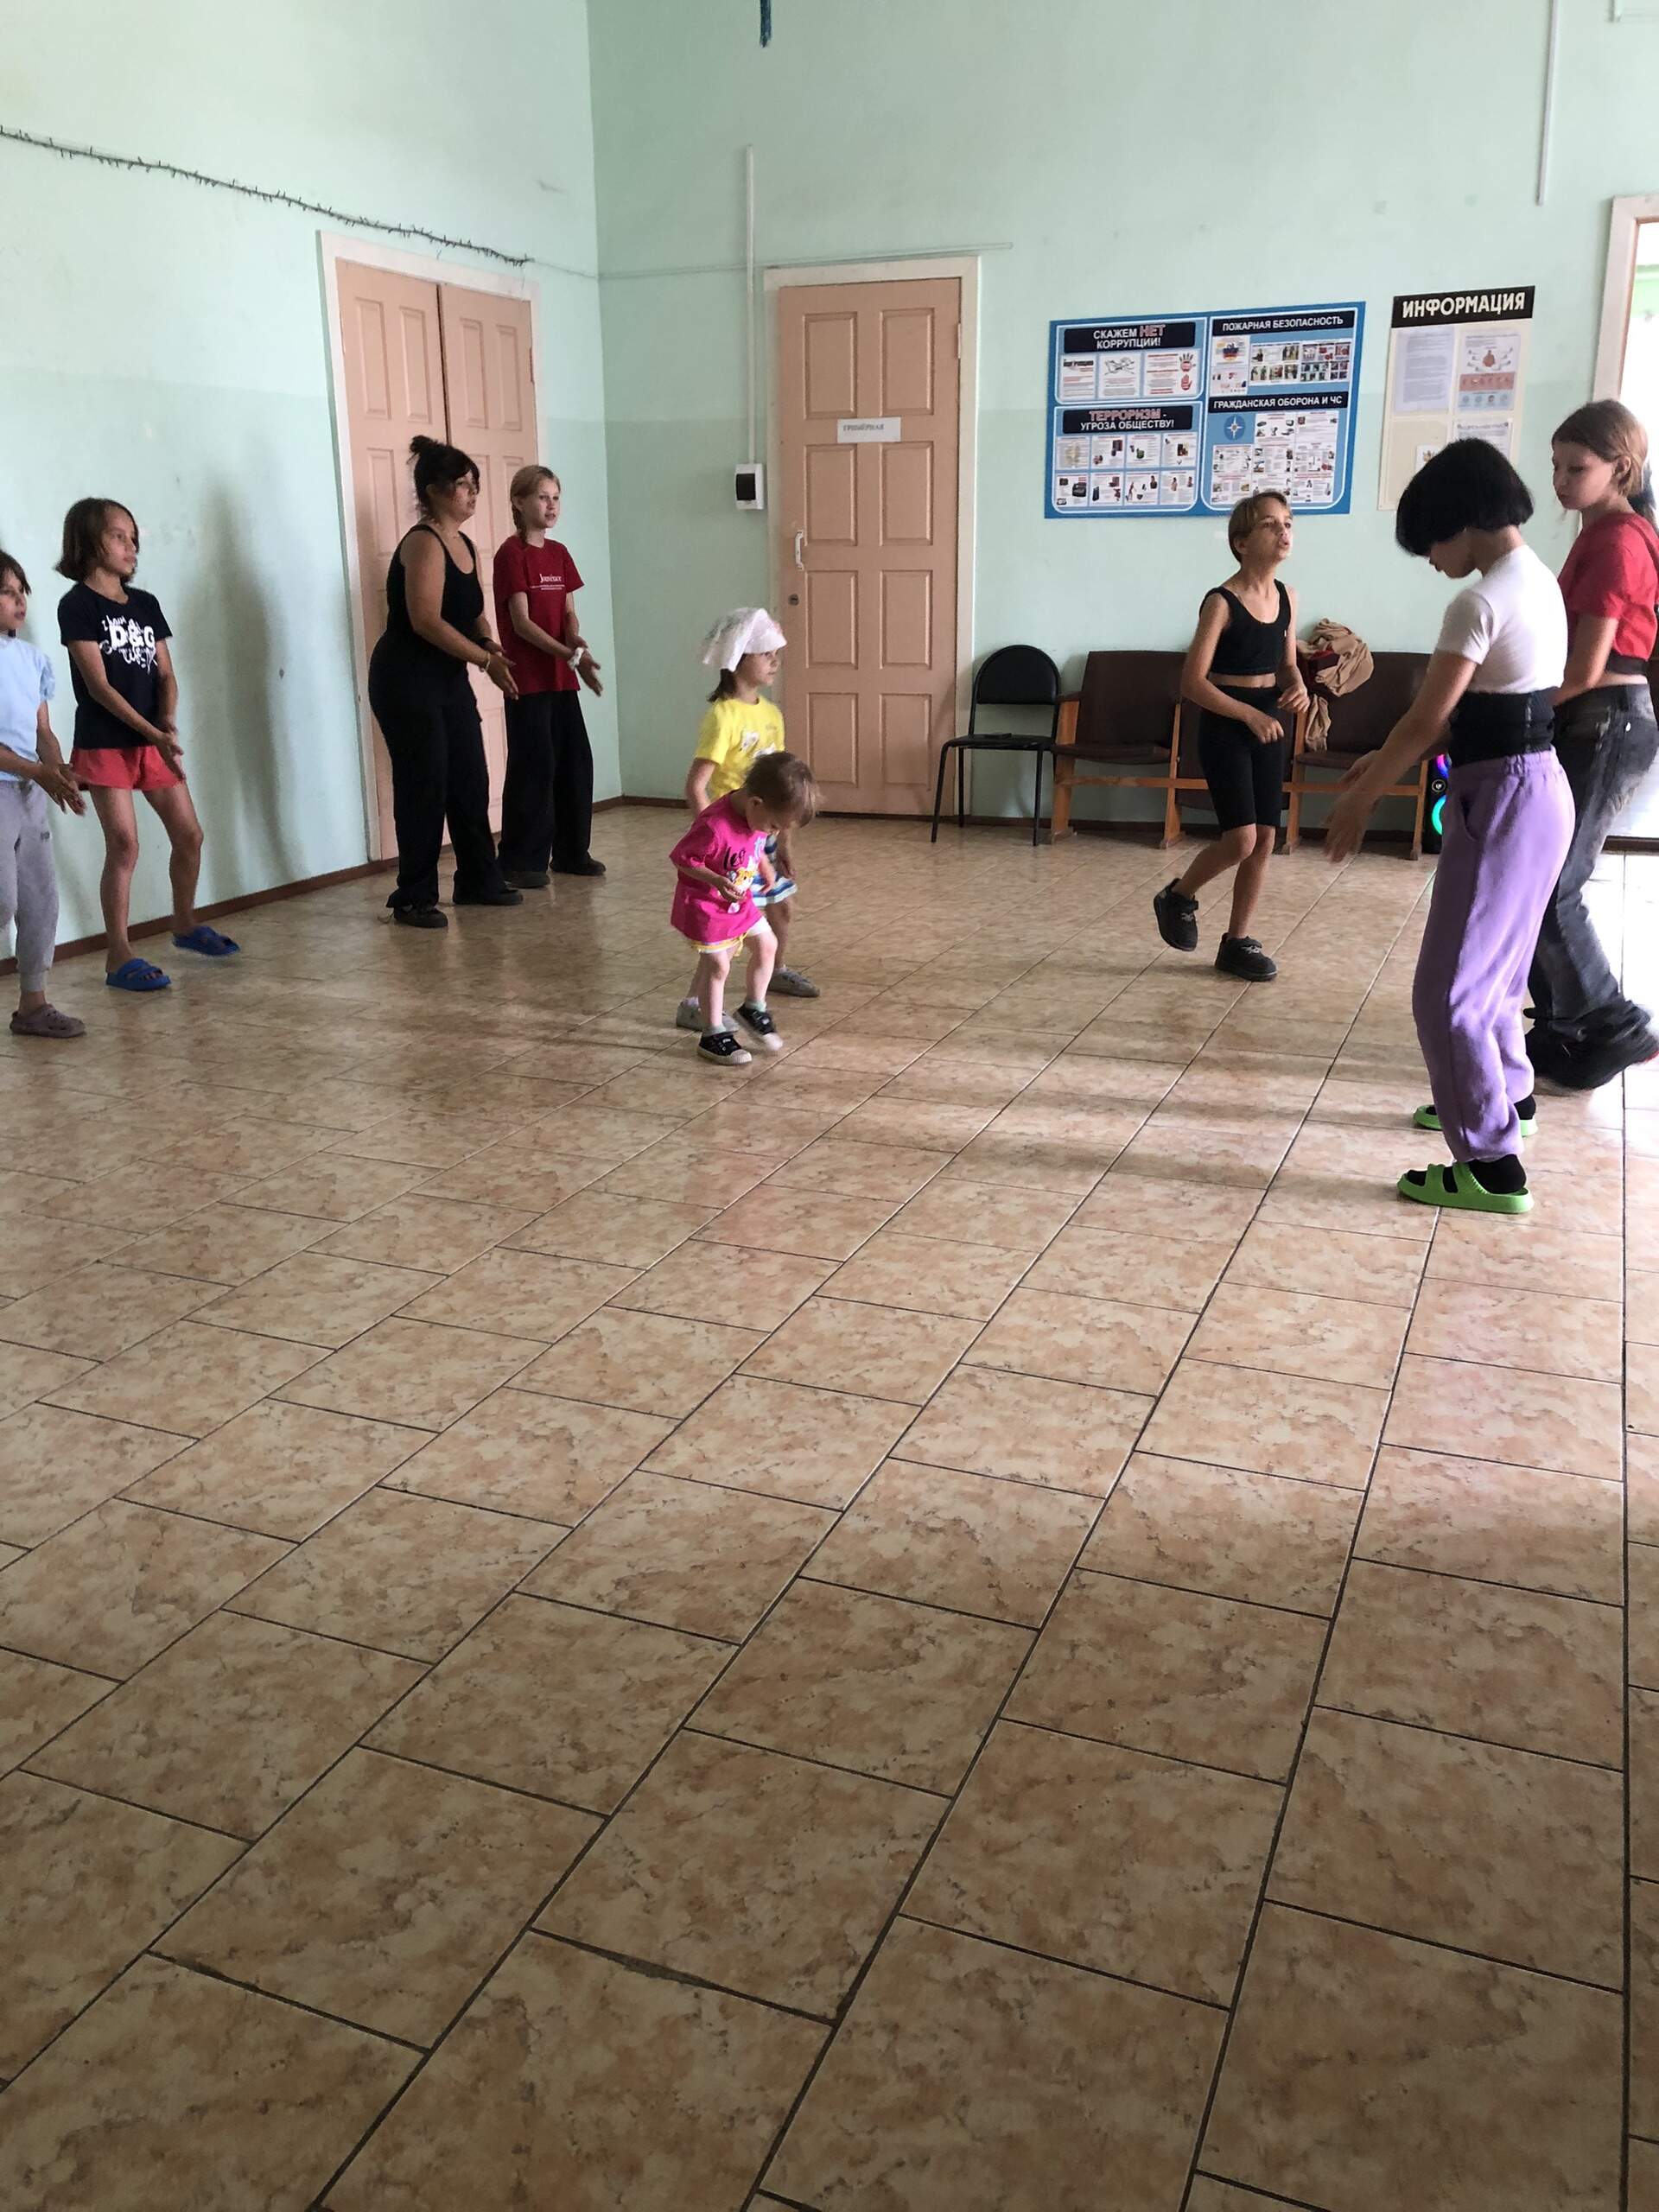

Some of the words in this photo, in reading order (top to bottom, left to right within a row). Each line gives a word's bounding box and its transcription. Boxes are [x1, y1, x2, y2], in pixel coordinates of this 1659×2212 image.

[1402, 292, 1525, 318] ИНФОРМАЦИЯ
[1093, 328, 1137, 339] СКАЖЕМ
[1139, 324, 1166, 337] НЕТ
[1223, 321, 1271, 332] ПОЖАРНАЯ
[1273, 316, 1344, 328] БЕЗОПАСНОСТЬ
[1096, 337, 1161, 349] КОРРУПЦИИ!
[1214, 399, 1275, 410] ГРАЖДАНСКАЯ
[1277, 397, 1320, 407] ОБОРОНА
[1322, 397, 1328, 405] И
[1330, 395, 1343, 404] ЧС
[1089, 409, 1161, 422] ТЕРРОРИЗМ
[1080, 422, 1116, 430] УГРОЗА
[1118, 419, 1174, 429] ОБЩЕСТВУ!
